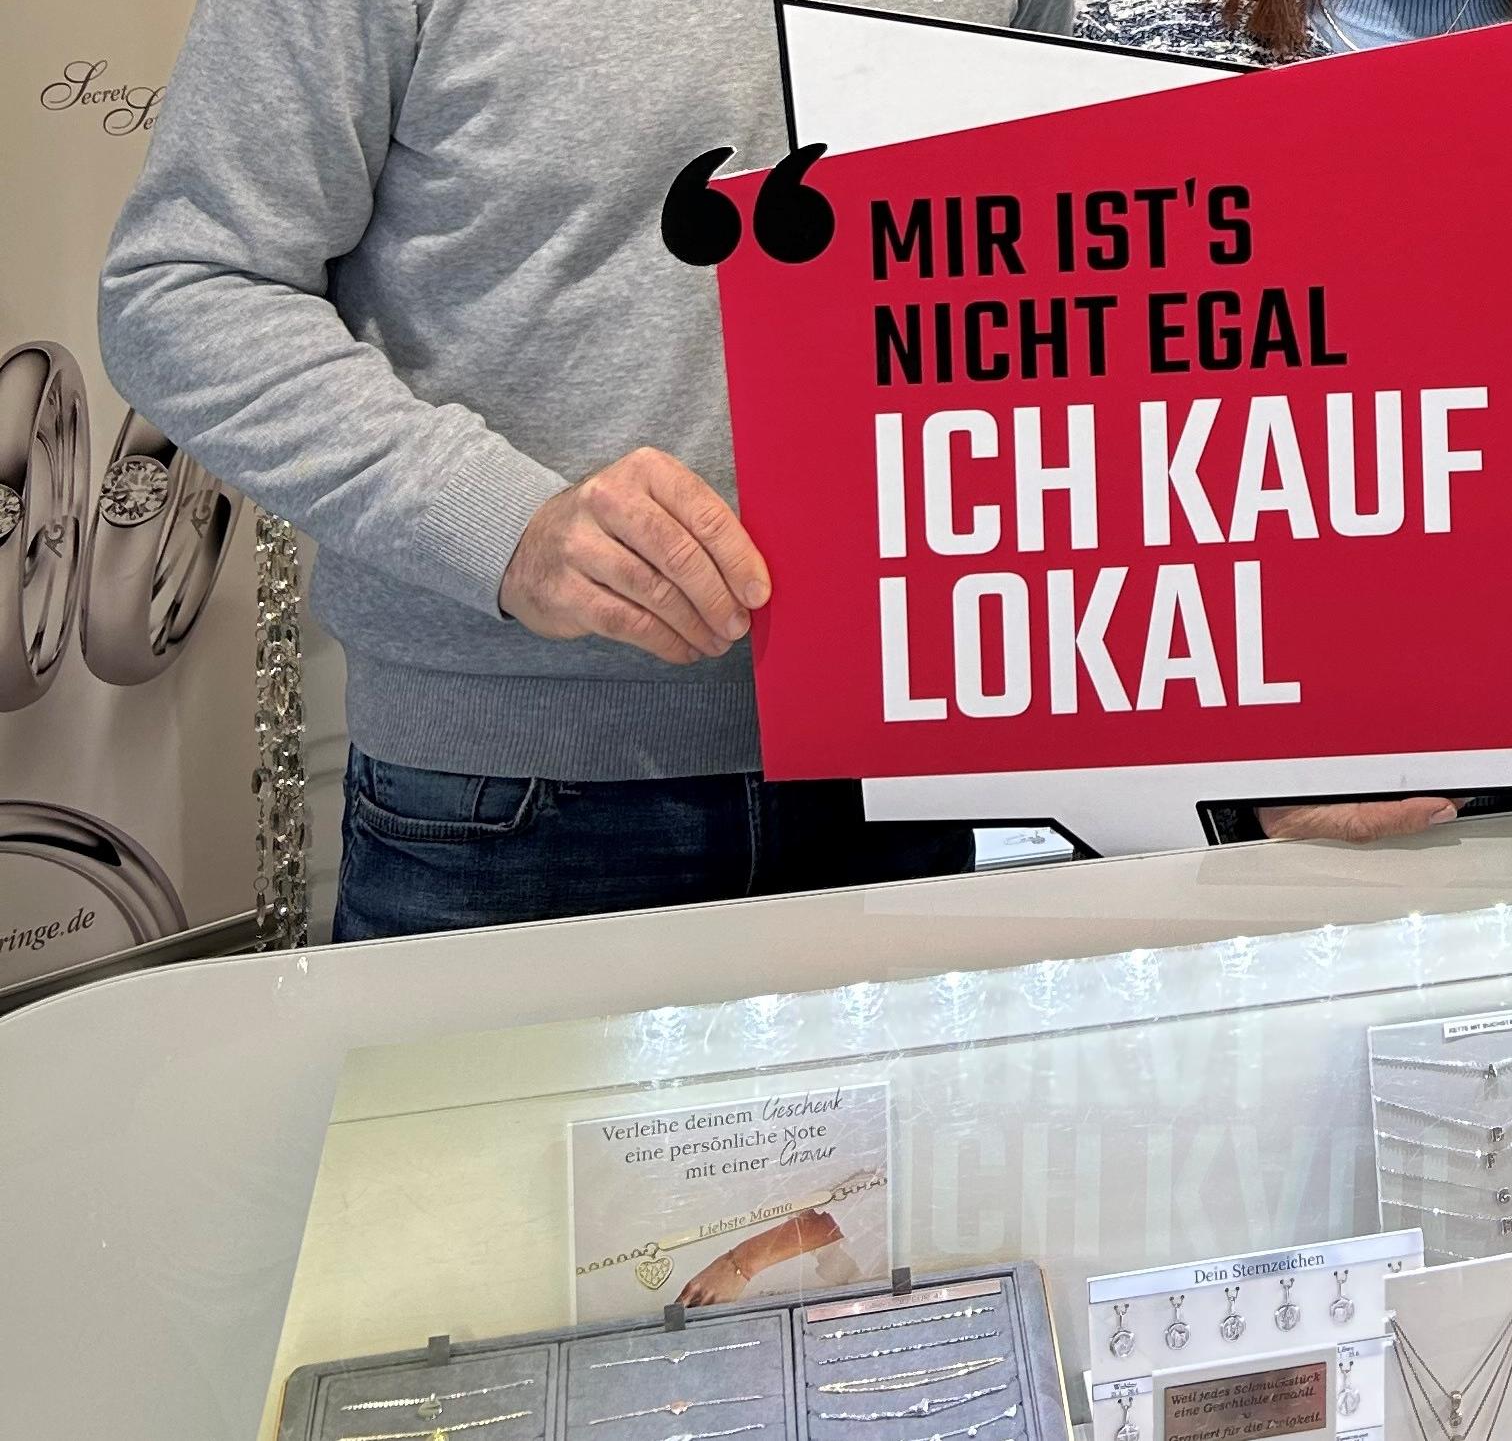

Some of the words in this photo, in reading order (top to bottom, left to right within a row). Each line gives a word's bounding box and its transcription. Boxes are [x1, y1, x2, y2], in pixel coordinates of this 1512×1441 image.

[41, 59, 128, 111] Secret
[869, 191, 1025, 283] MIR
[1055, 177, 1253, 275] IST'S
[873, 294, 1119, 387] NICHT
[1148, 285, 1348, 375] EGAL
[874, 403, 1098, 560] ICH
[1140, 386, 1489, 548] KAUF
[878, 559, 1302, 723] LOKAL
[602, 1119, 680, 1142] Verleihe
[685, 1110, 753, 1131] deinem
[762, 1088, 844, 1121] Geschenk
[625, 1147, 664, 1164] eine
[670, 1129, 777, 1162] persönliche
[783, 1123, 827, 1142] Note
[685, 1164, 717, 1180] mit
[722, 1156, 770, 1175] einer
[780, 1139, 837, 1167] Gravur
[699, 1214, 747, 1238] Liebste
[749, 1201, 794, 1223] Mama
[1194, 1266, 1228, 1284] Dein
[1232, 1253, 1326, 1278] Sternzeichen
[1171, 1391, 1197, 1406] Weil
[1199, 1386, 1230, 1402] jedes
[1233, 1371, 1322, 1395] Schmuckstück
[1174, 1406, 1200, 1418] eine
[1203, 1393, 1269, 1414] Geschichte
[1221, 1424, 1241, 1440] für
[1243, 1421, 1263, 1433] die
